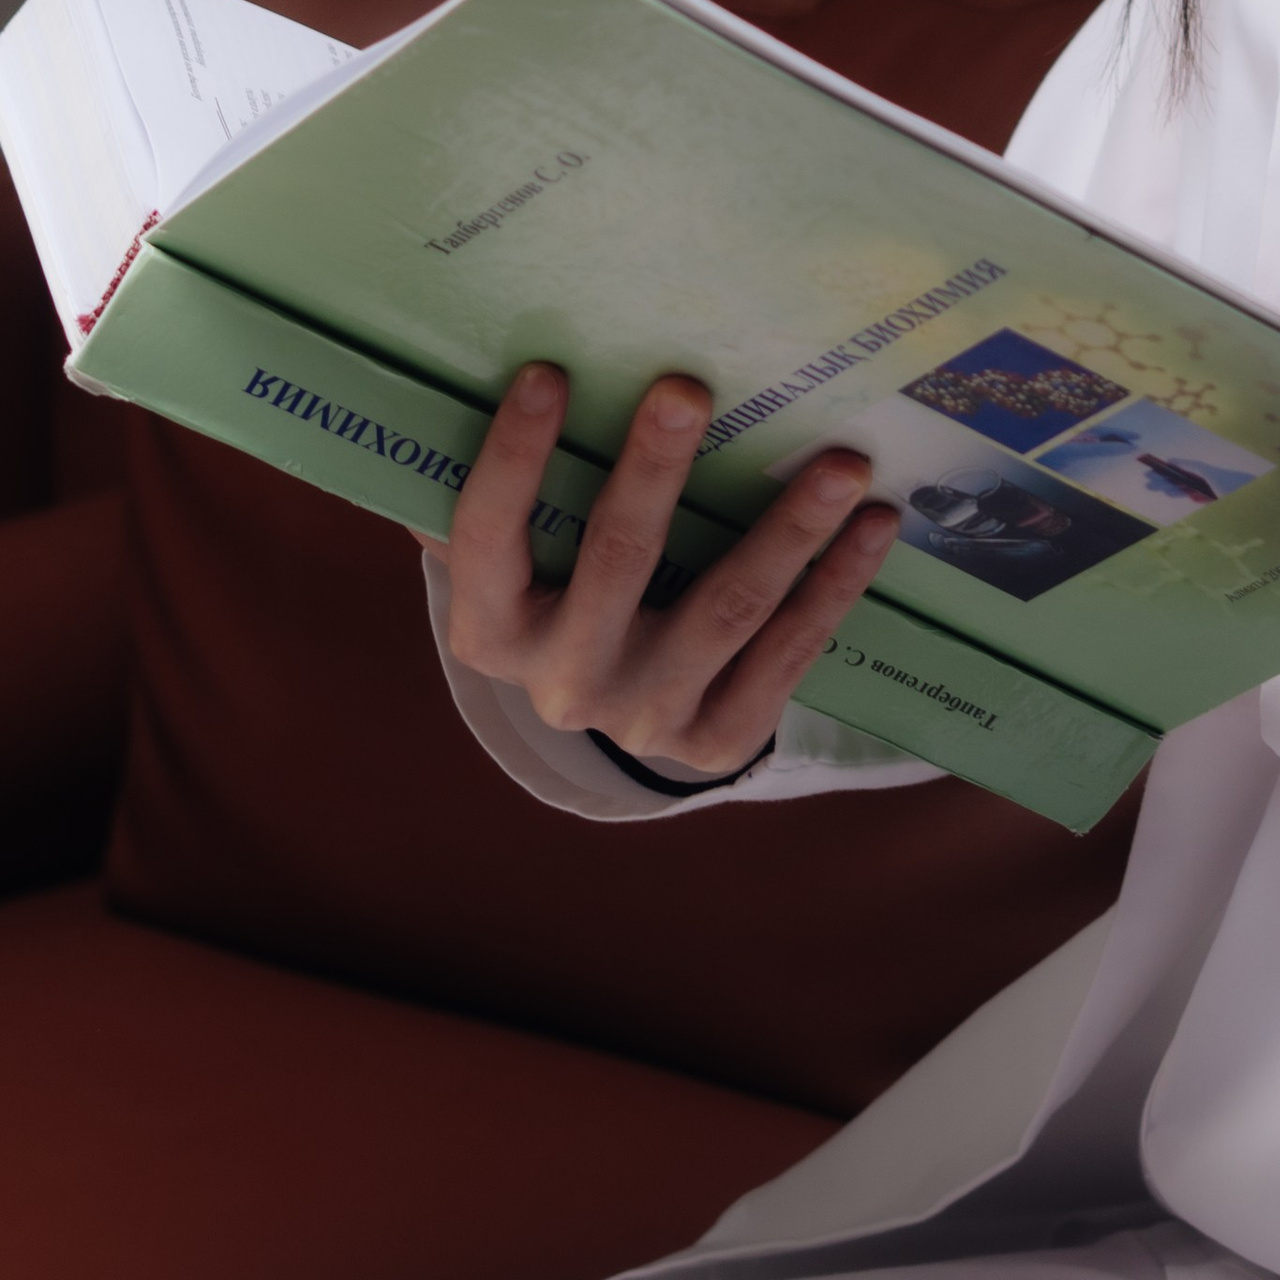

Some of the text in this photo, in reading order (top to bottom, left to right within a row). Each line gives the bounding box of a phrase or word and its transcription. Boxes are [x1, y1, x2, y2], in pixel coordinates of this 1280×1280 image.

[424, 181, 543, 255] Тапбергенов
[850, 258, 1007, 354] БИОХИМИЯ
[243, 367, 472, 493] БИОХИМИЯ
[844, 646, 866, 667] С.
[871, 659, 999, 732] Тапбергенов
